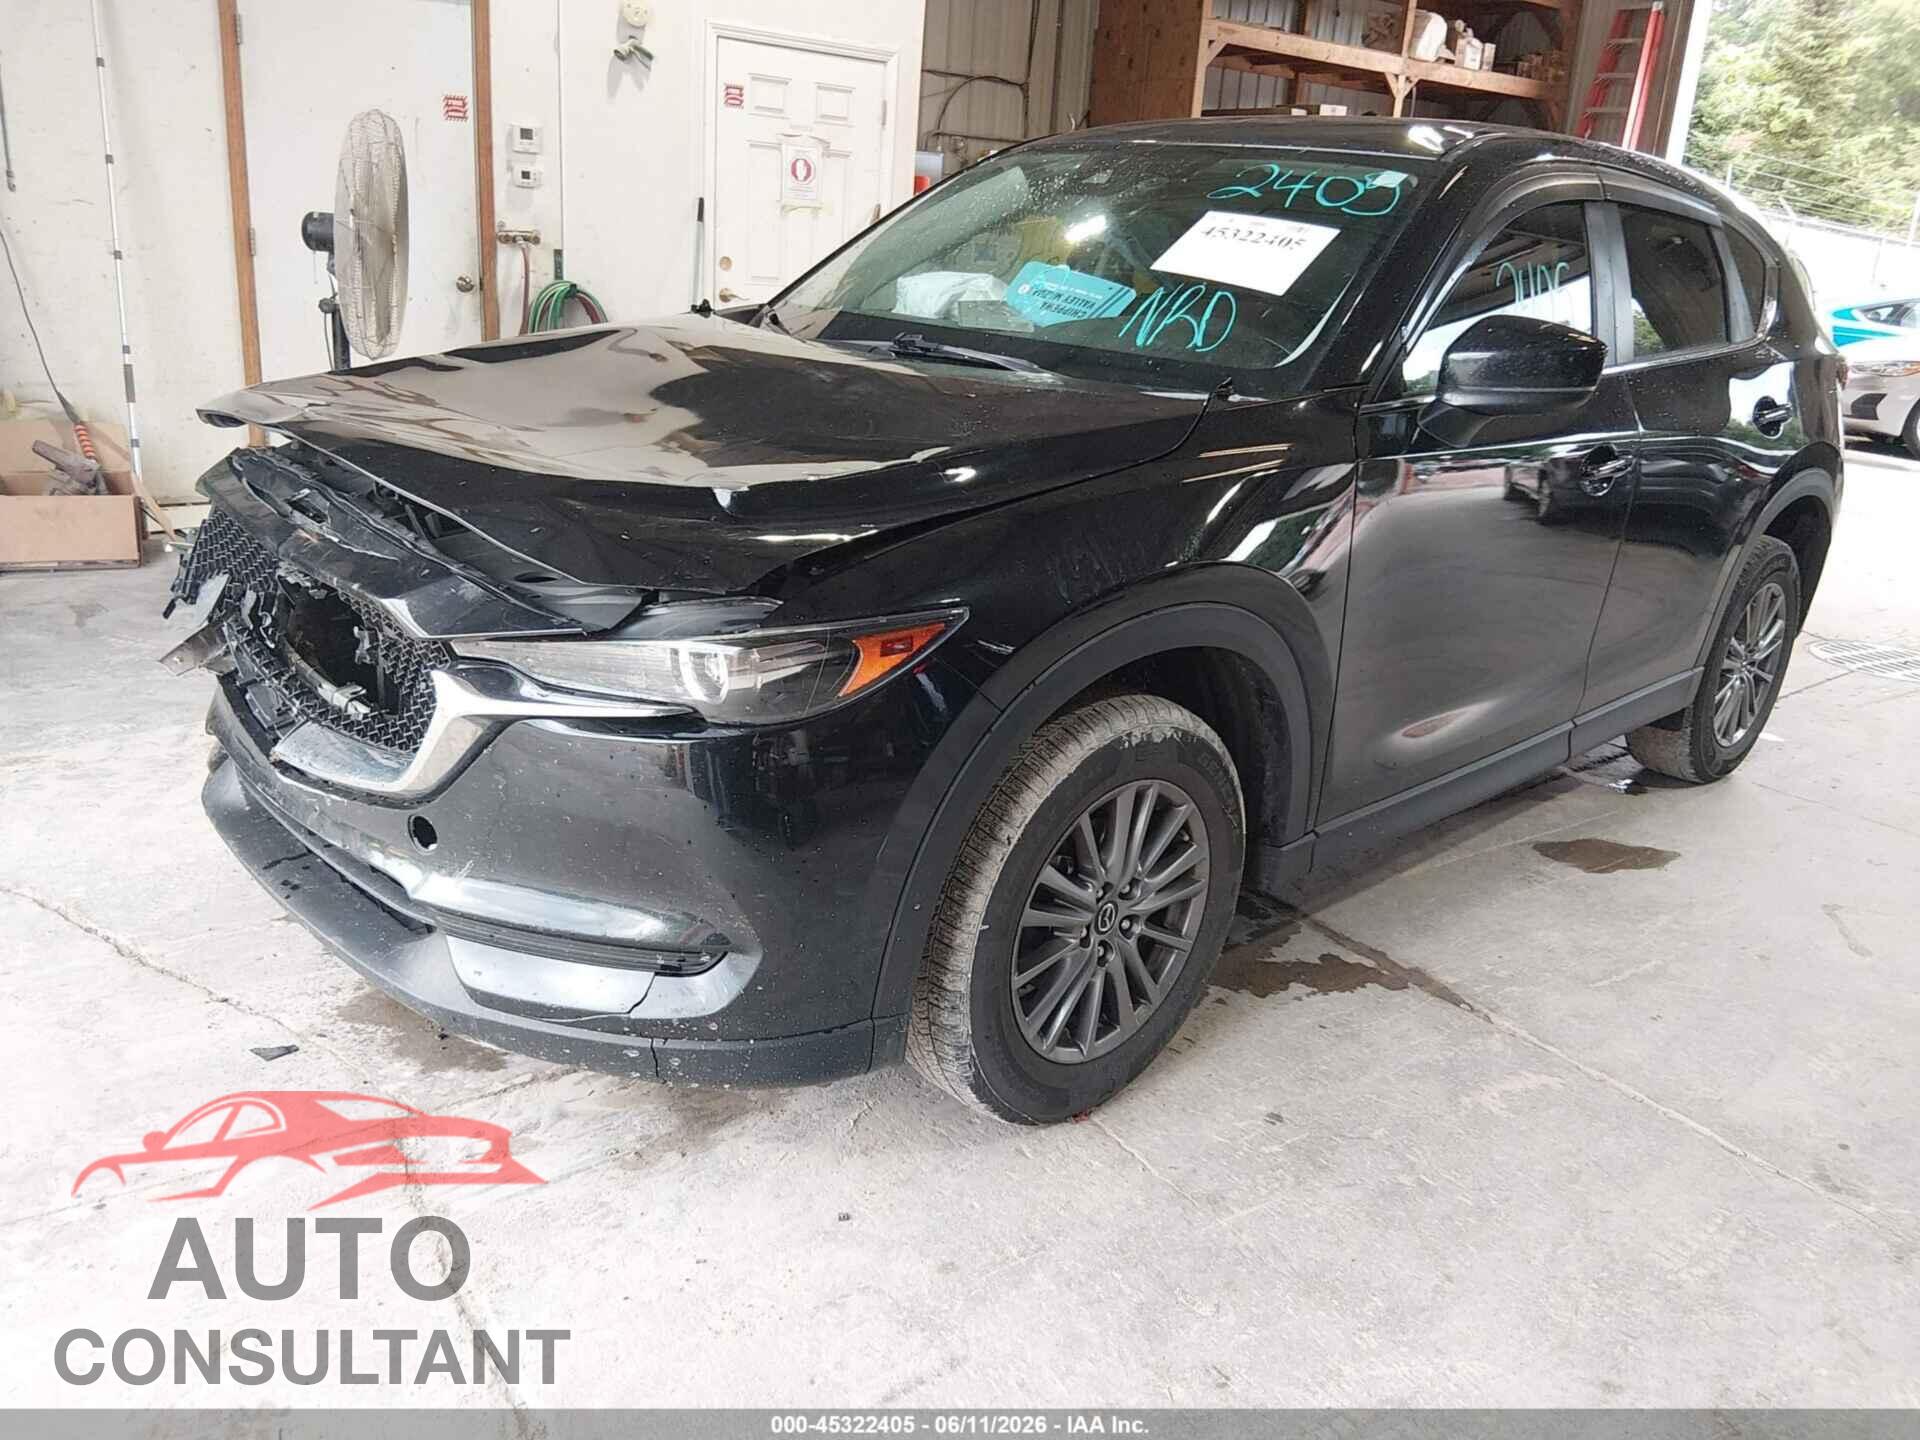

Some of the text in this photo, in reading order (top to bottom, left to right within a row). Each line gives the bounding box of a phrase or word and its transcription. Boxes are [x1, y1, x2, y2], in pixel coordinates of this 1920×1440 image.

[1206, 164, 1401, 216] 2405
[1201, 226, 1307, 250] 45322405
[1063, 295, 1097, 310] VALLEY
